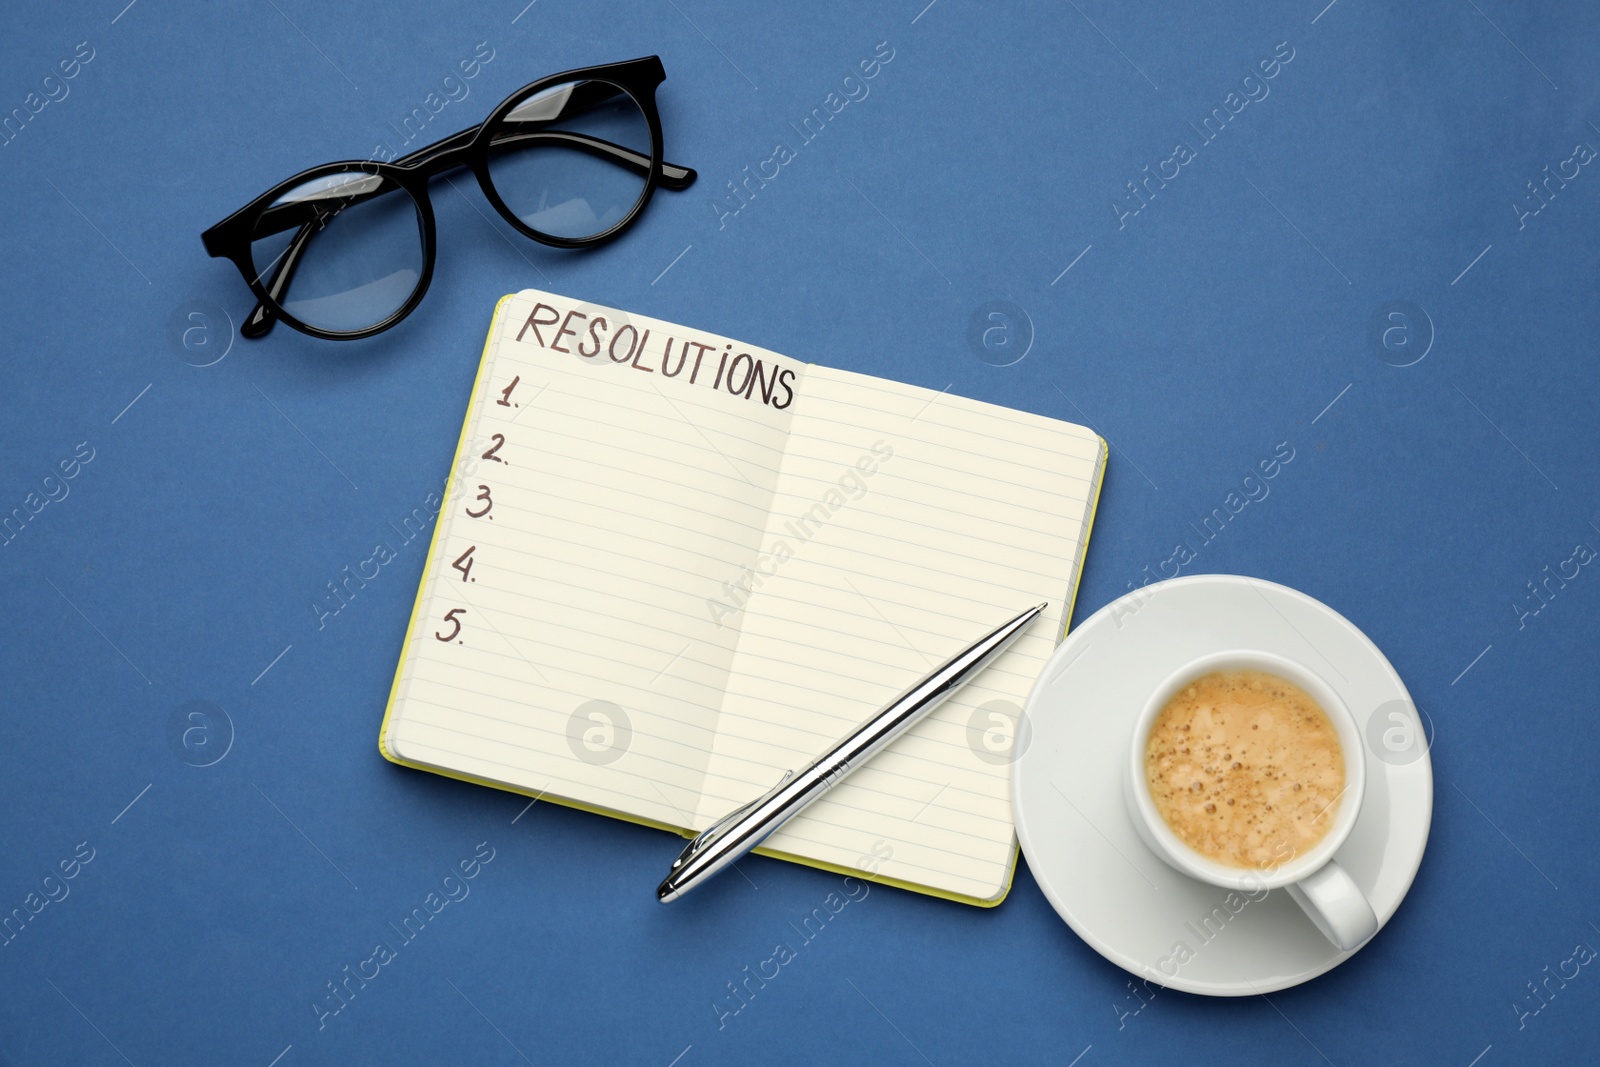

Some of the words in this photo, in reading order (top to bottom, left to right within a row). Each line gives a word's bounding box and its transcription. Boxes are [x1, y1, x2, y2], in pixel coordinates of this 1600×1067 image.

[496, 375, 520, 408] 1.
[481, 433, 509, 466] 2.
[465, 484, 493, 521] 3.
[452, 545, 476, 583] 4.
[435, 608, 467, 645] 5.
